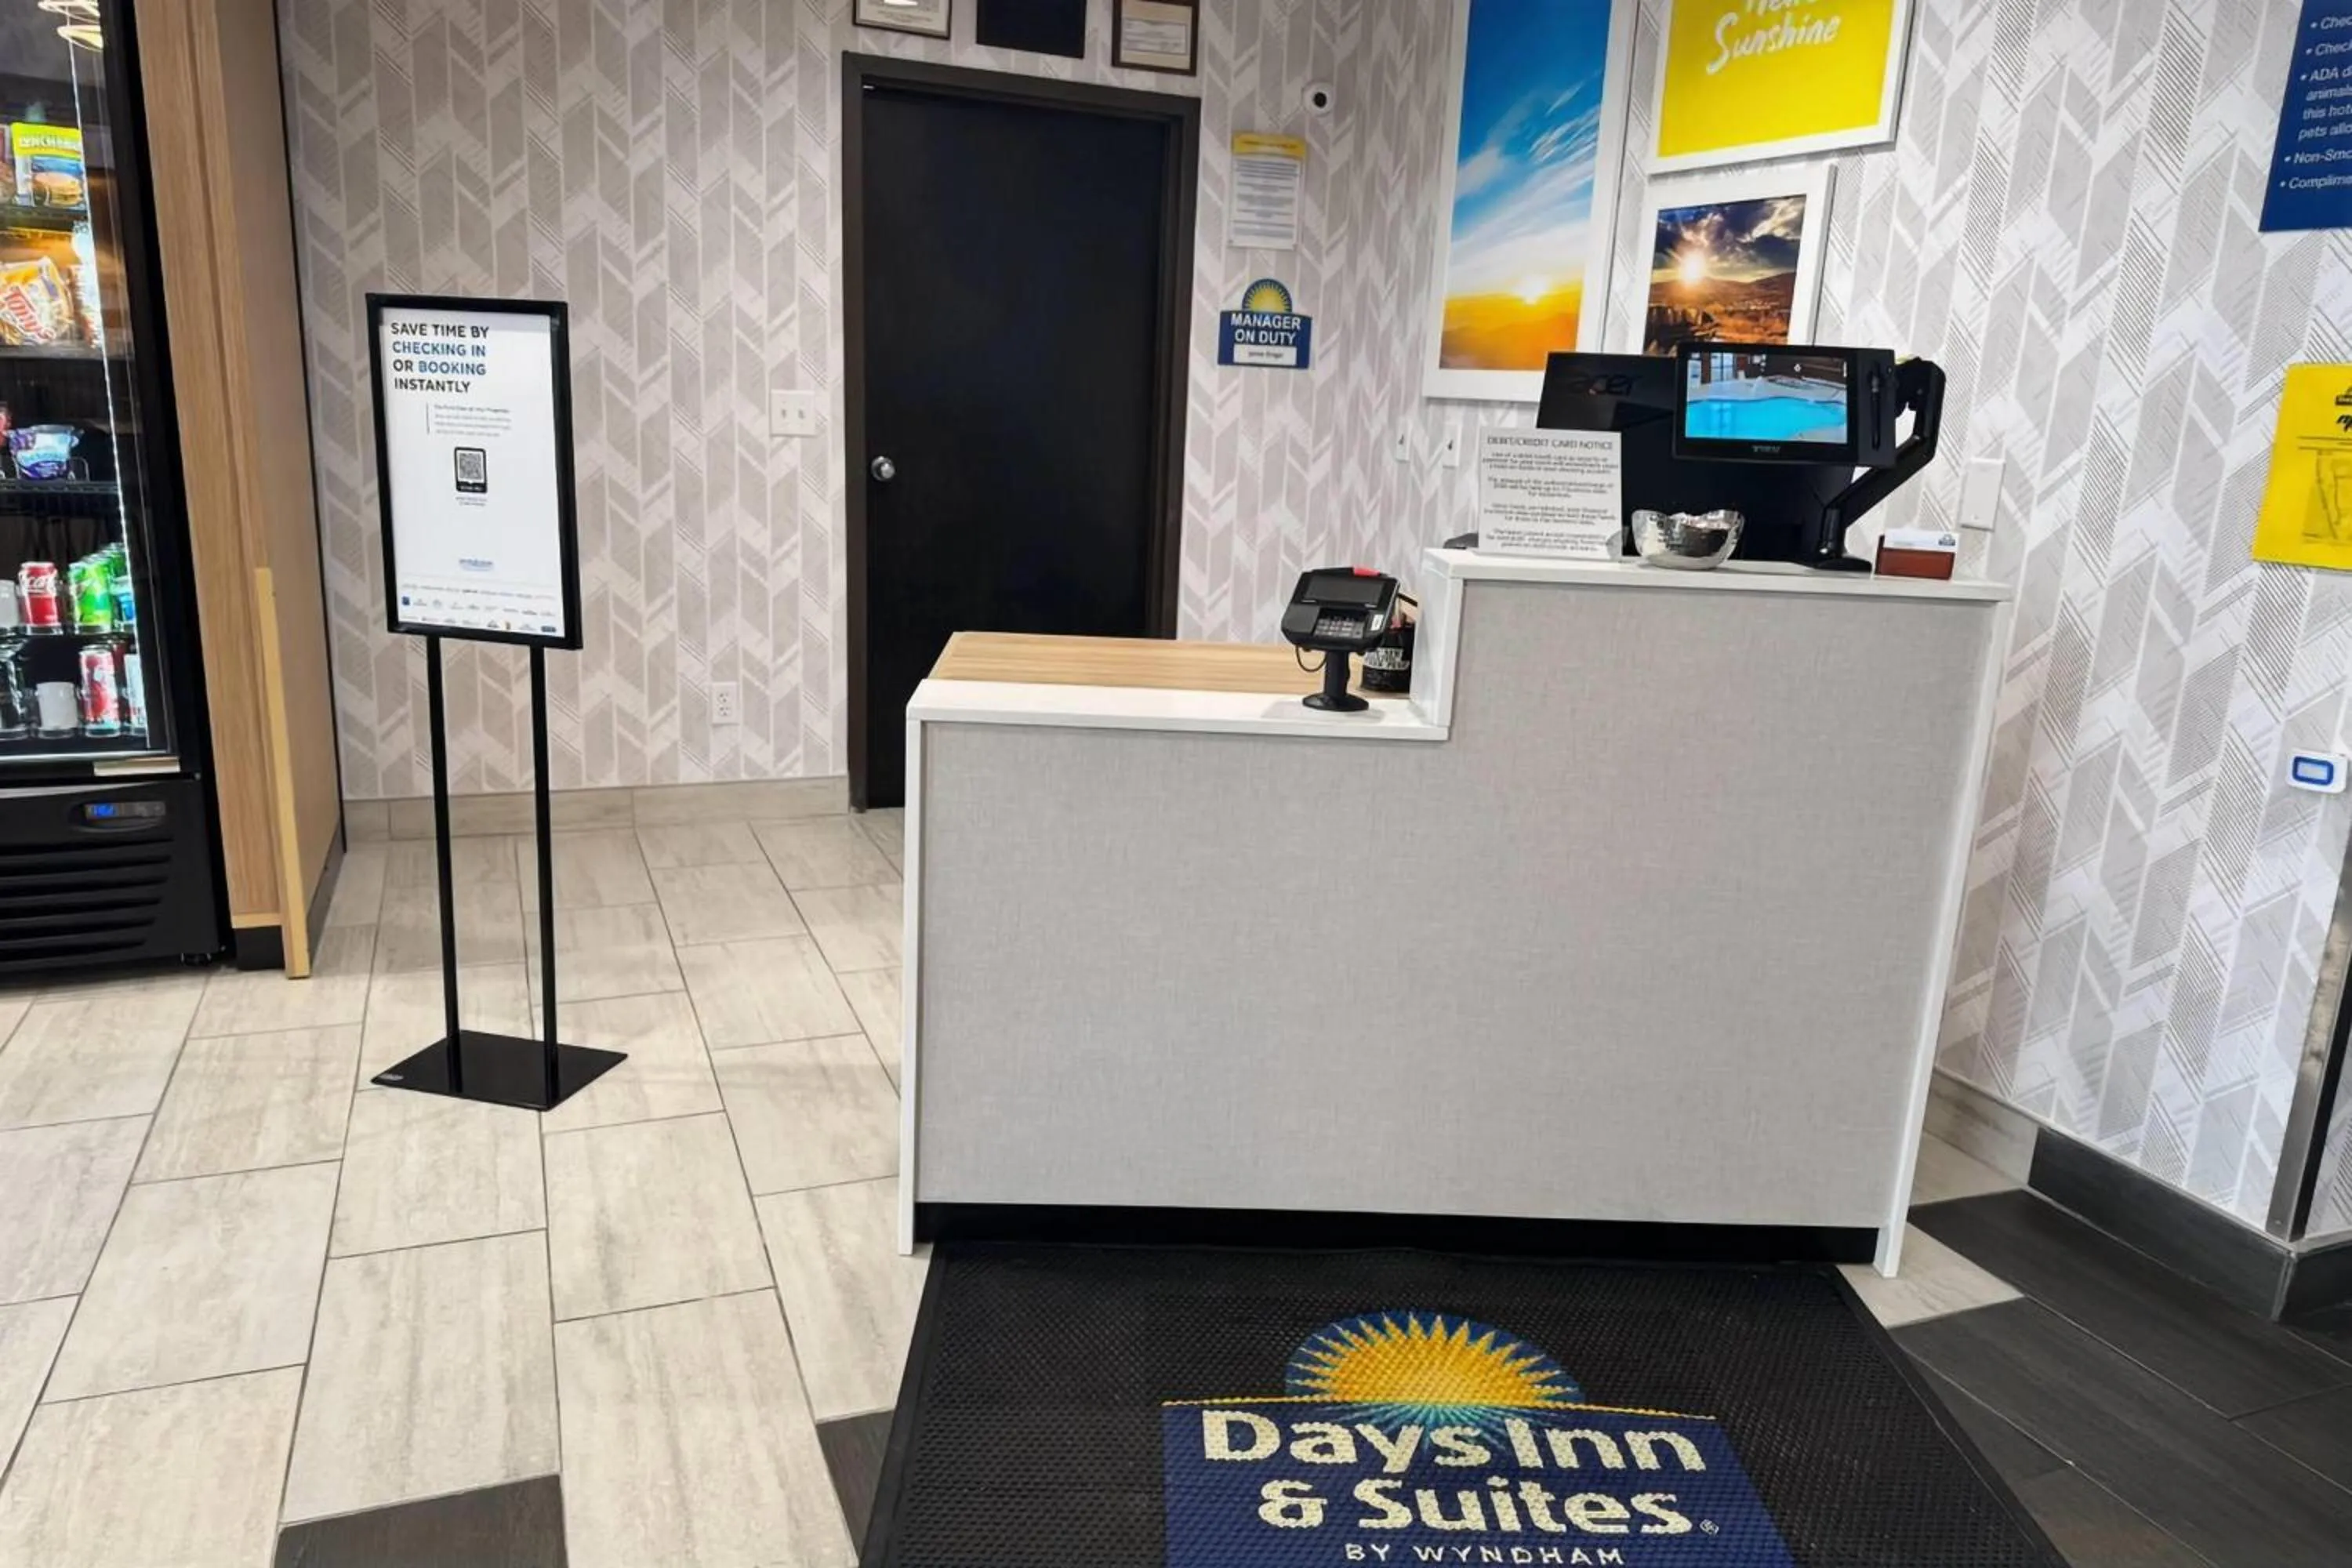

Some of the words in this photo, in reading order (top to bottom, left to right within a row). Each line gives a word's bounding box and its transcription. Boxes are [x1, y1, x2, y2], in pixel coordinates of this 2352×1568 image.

[1705, 12, 1841, 74] Sunshine
[2309, 67, 2339, 82] ADA
[2303, 107, 2326, 119] this
[2298, 125, 2327, 142] pets
[1230, 313, 1301, 330] MANAGER
[390, 322, 427, 336] SAVE
[432, 324, 466, 338] TIME
[470, 325, 489, 339] BY
[1235, 328, 1255, 343] ON
[1259, 330, 1297, 345] DUTY
[392, 341, 466, 356] CHECKING
[471, 344, 486, 357] IN
[393, 359, 413, 372] OR
[419, 361, 487, 376] BOOKING
[394, 378, 470, 393] INSTANTLY
[1202, 1410, 1490, 1474] Days
[1504, 1417, 1707, 1471] Inn
[1258, 1479, 1327, 1528] &
[1353, 1475, 1693, 1534] Suites
[1345, 1543, 1390, 1563] BY
[1412, 1544, 1626, 1566] WYNDHAM
